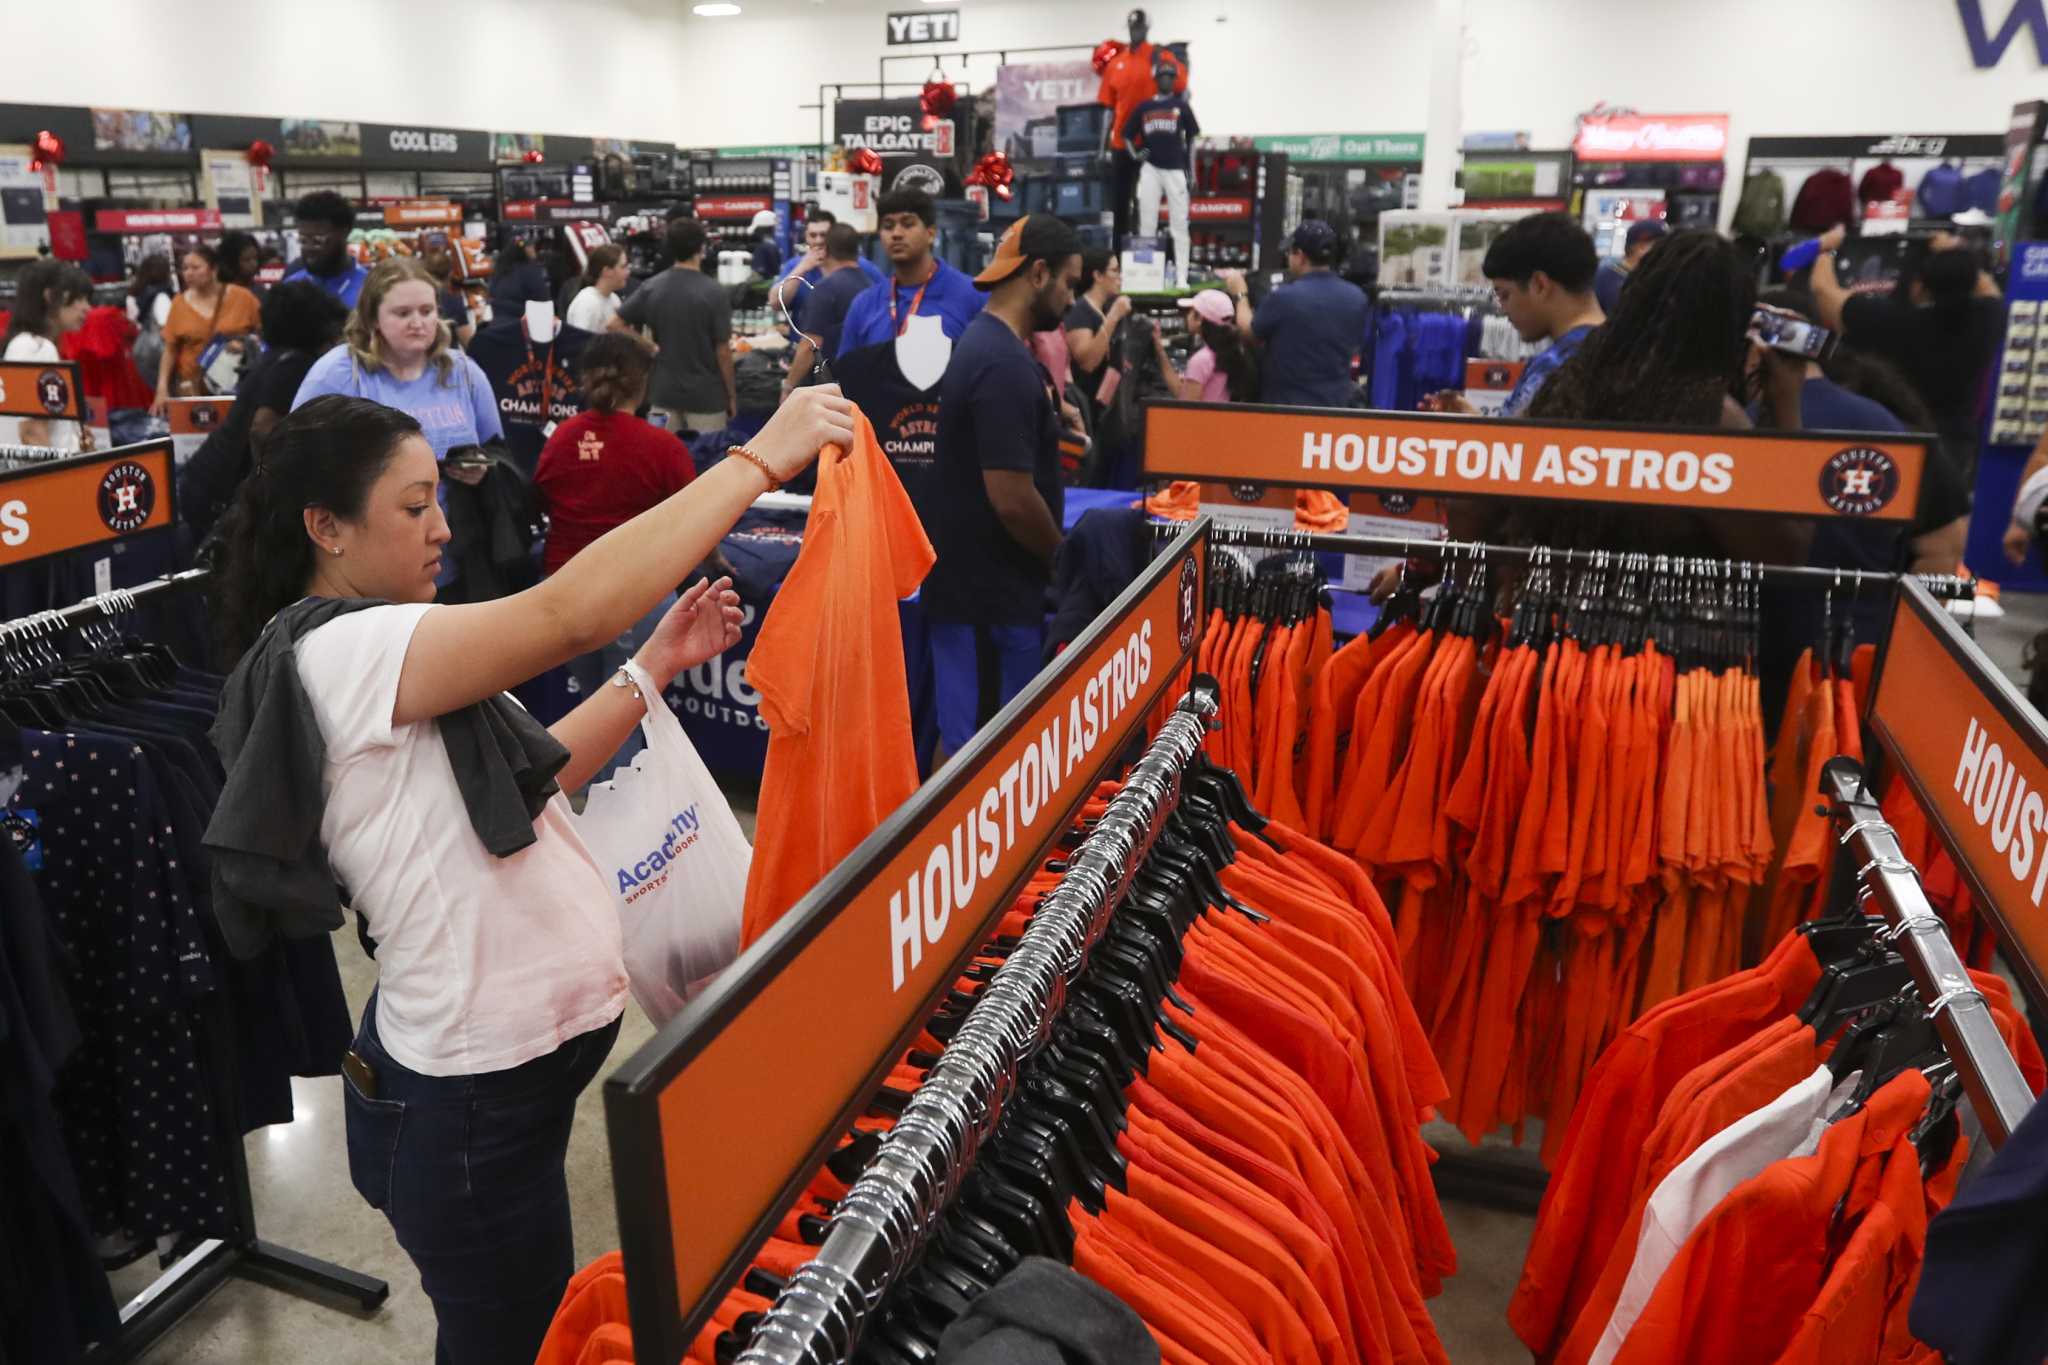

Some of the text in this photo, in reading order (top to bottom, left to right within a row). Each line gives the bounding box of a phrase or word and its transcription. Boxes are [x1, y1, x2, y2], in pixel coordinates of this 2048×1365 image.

[889, 13, 958, 42] YETI
[1024, 79, 1083, 100] YETI
[864, 116, 912, 132] EPIC
[390, 131, 457, 152] COOLERS
[500, 398, 577, 417] CHAMIONS
[885, 441, 935, 454] CHAMPI
[1301, 431, 1735, 493] HOUSTON ASTROS
[1831, 449, 1892, 470] HOUSTON
[104, 465, 147, 489] HOUSTON
[1843, 469, 1874, 494] H
[115, 484, 138, 513] H
[109, 509, 148, 531] ASTROS
[889, 618, 1152, 992] HOUSTON ASTROS
[617, 804, 700, 894] Acadmy
